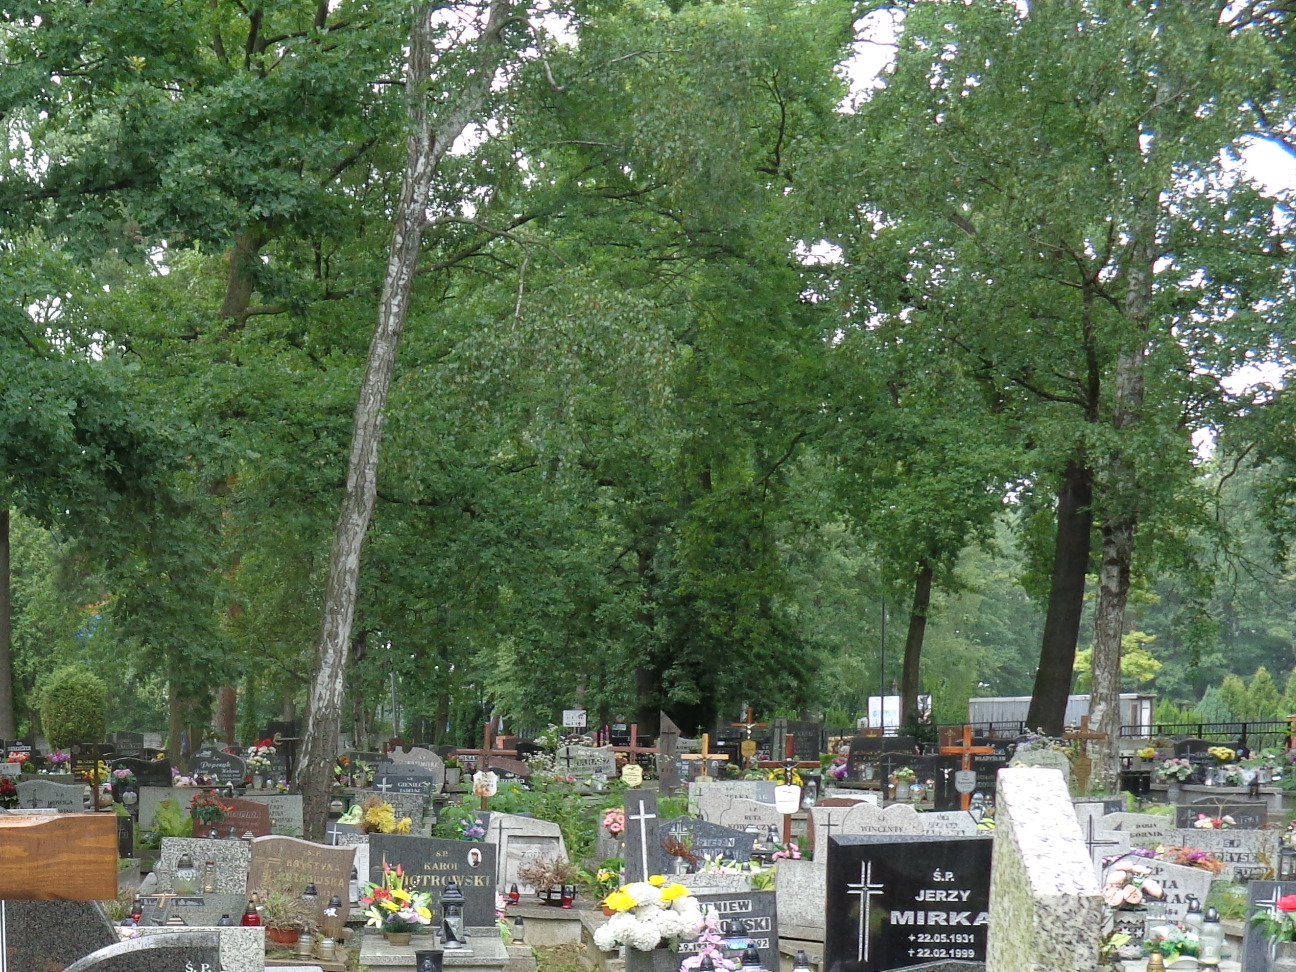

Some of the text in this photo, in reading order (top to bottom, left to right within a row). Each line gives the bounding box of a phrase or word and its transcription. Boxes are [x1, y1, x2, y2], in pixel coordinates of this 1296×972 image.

[404, 874, 491, 887] IOTROWSKI
[914, 889, 971, 902] JERZY
[917, 933, 975, 943] 22.05.1931
[917, 948, 975, 958] 22.02.1999
